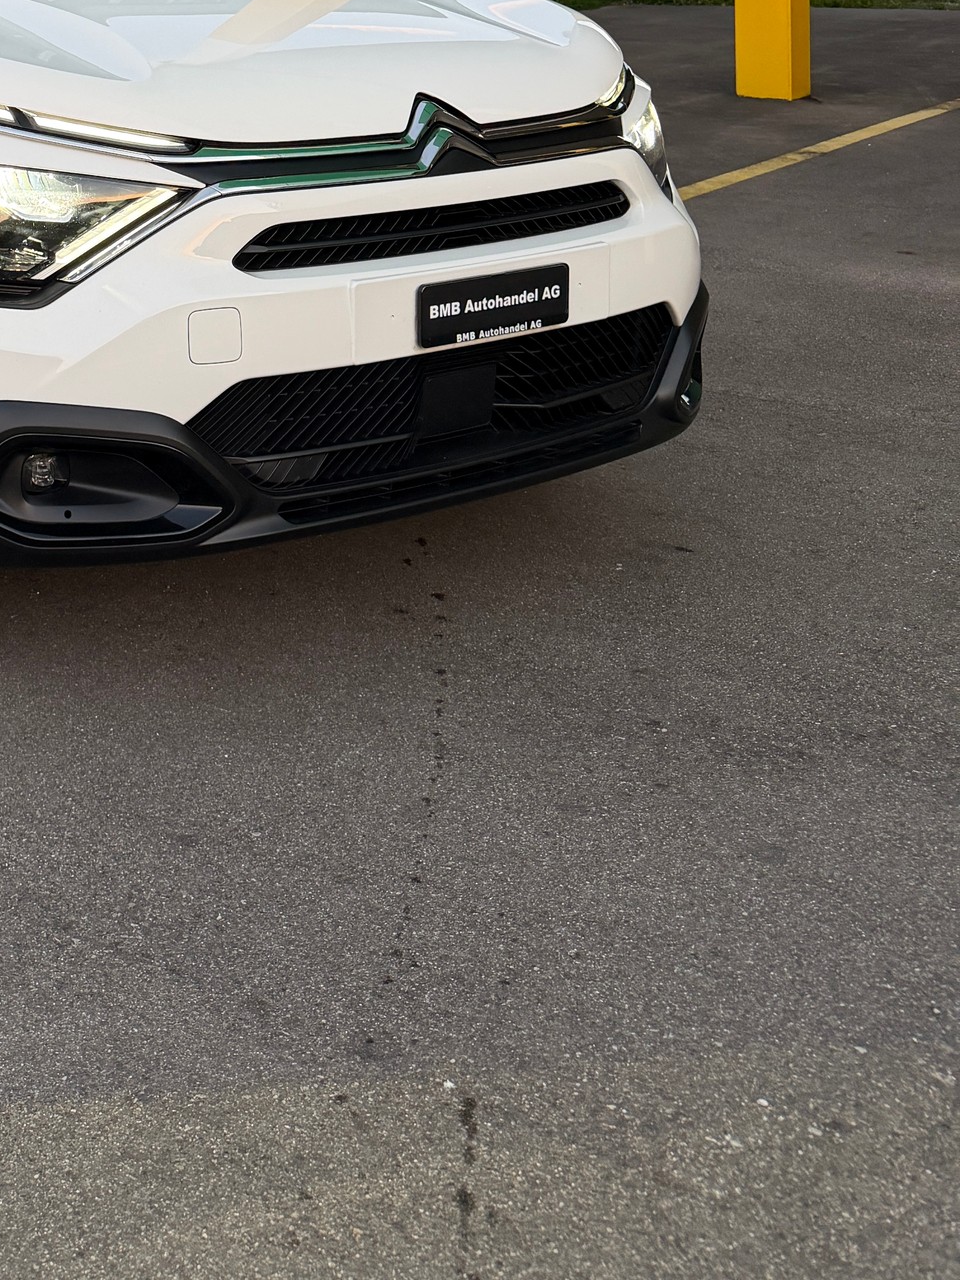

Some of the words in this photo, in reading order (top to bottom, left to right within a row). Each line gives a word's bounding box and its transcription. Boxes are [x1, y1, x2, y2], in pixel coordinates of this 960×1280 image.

[430, 301, 461, 320] BMB
[464, 288, 539, 314] Autohandel
[542, 284, 561, 300] AG
[456, 331, 476, 343] BMB
[479, 321, 528, 339] Autohandel
[530, 319, 542, 329] AG
